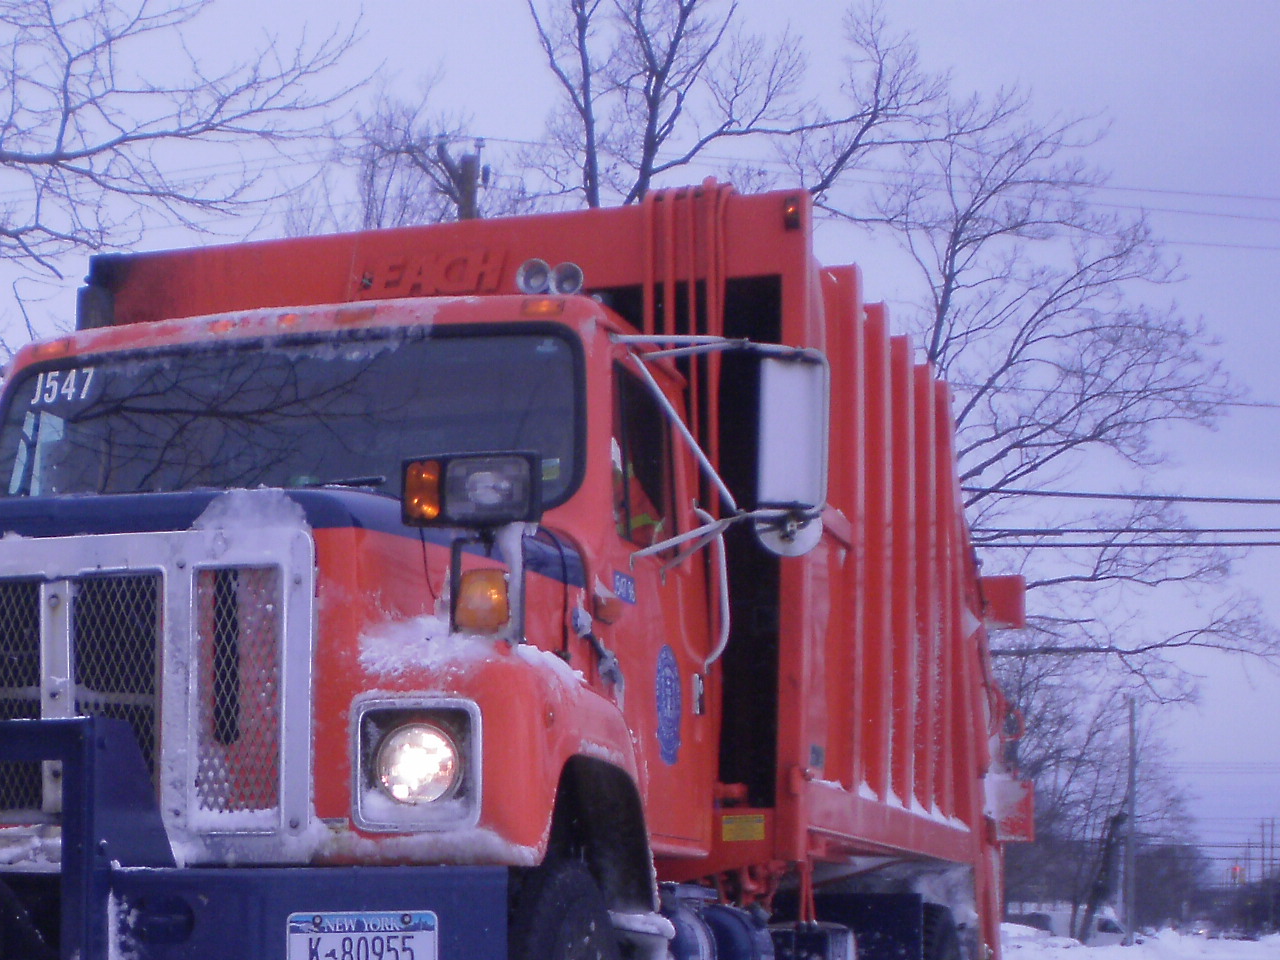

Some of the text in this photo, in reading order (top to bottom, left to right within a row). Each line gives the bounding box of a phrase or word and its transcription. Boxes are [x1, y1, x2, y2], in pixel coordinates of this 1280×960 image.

[31, 367, 94, 404] J547
[324, 917, 400, 932] NEW YORK
